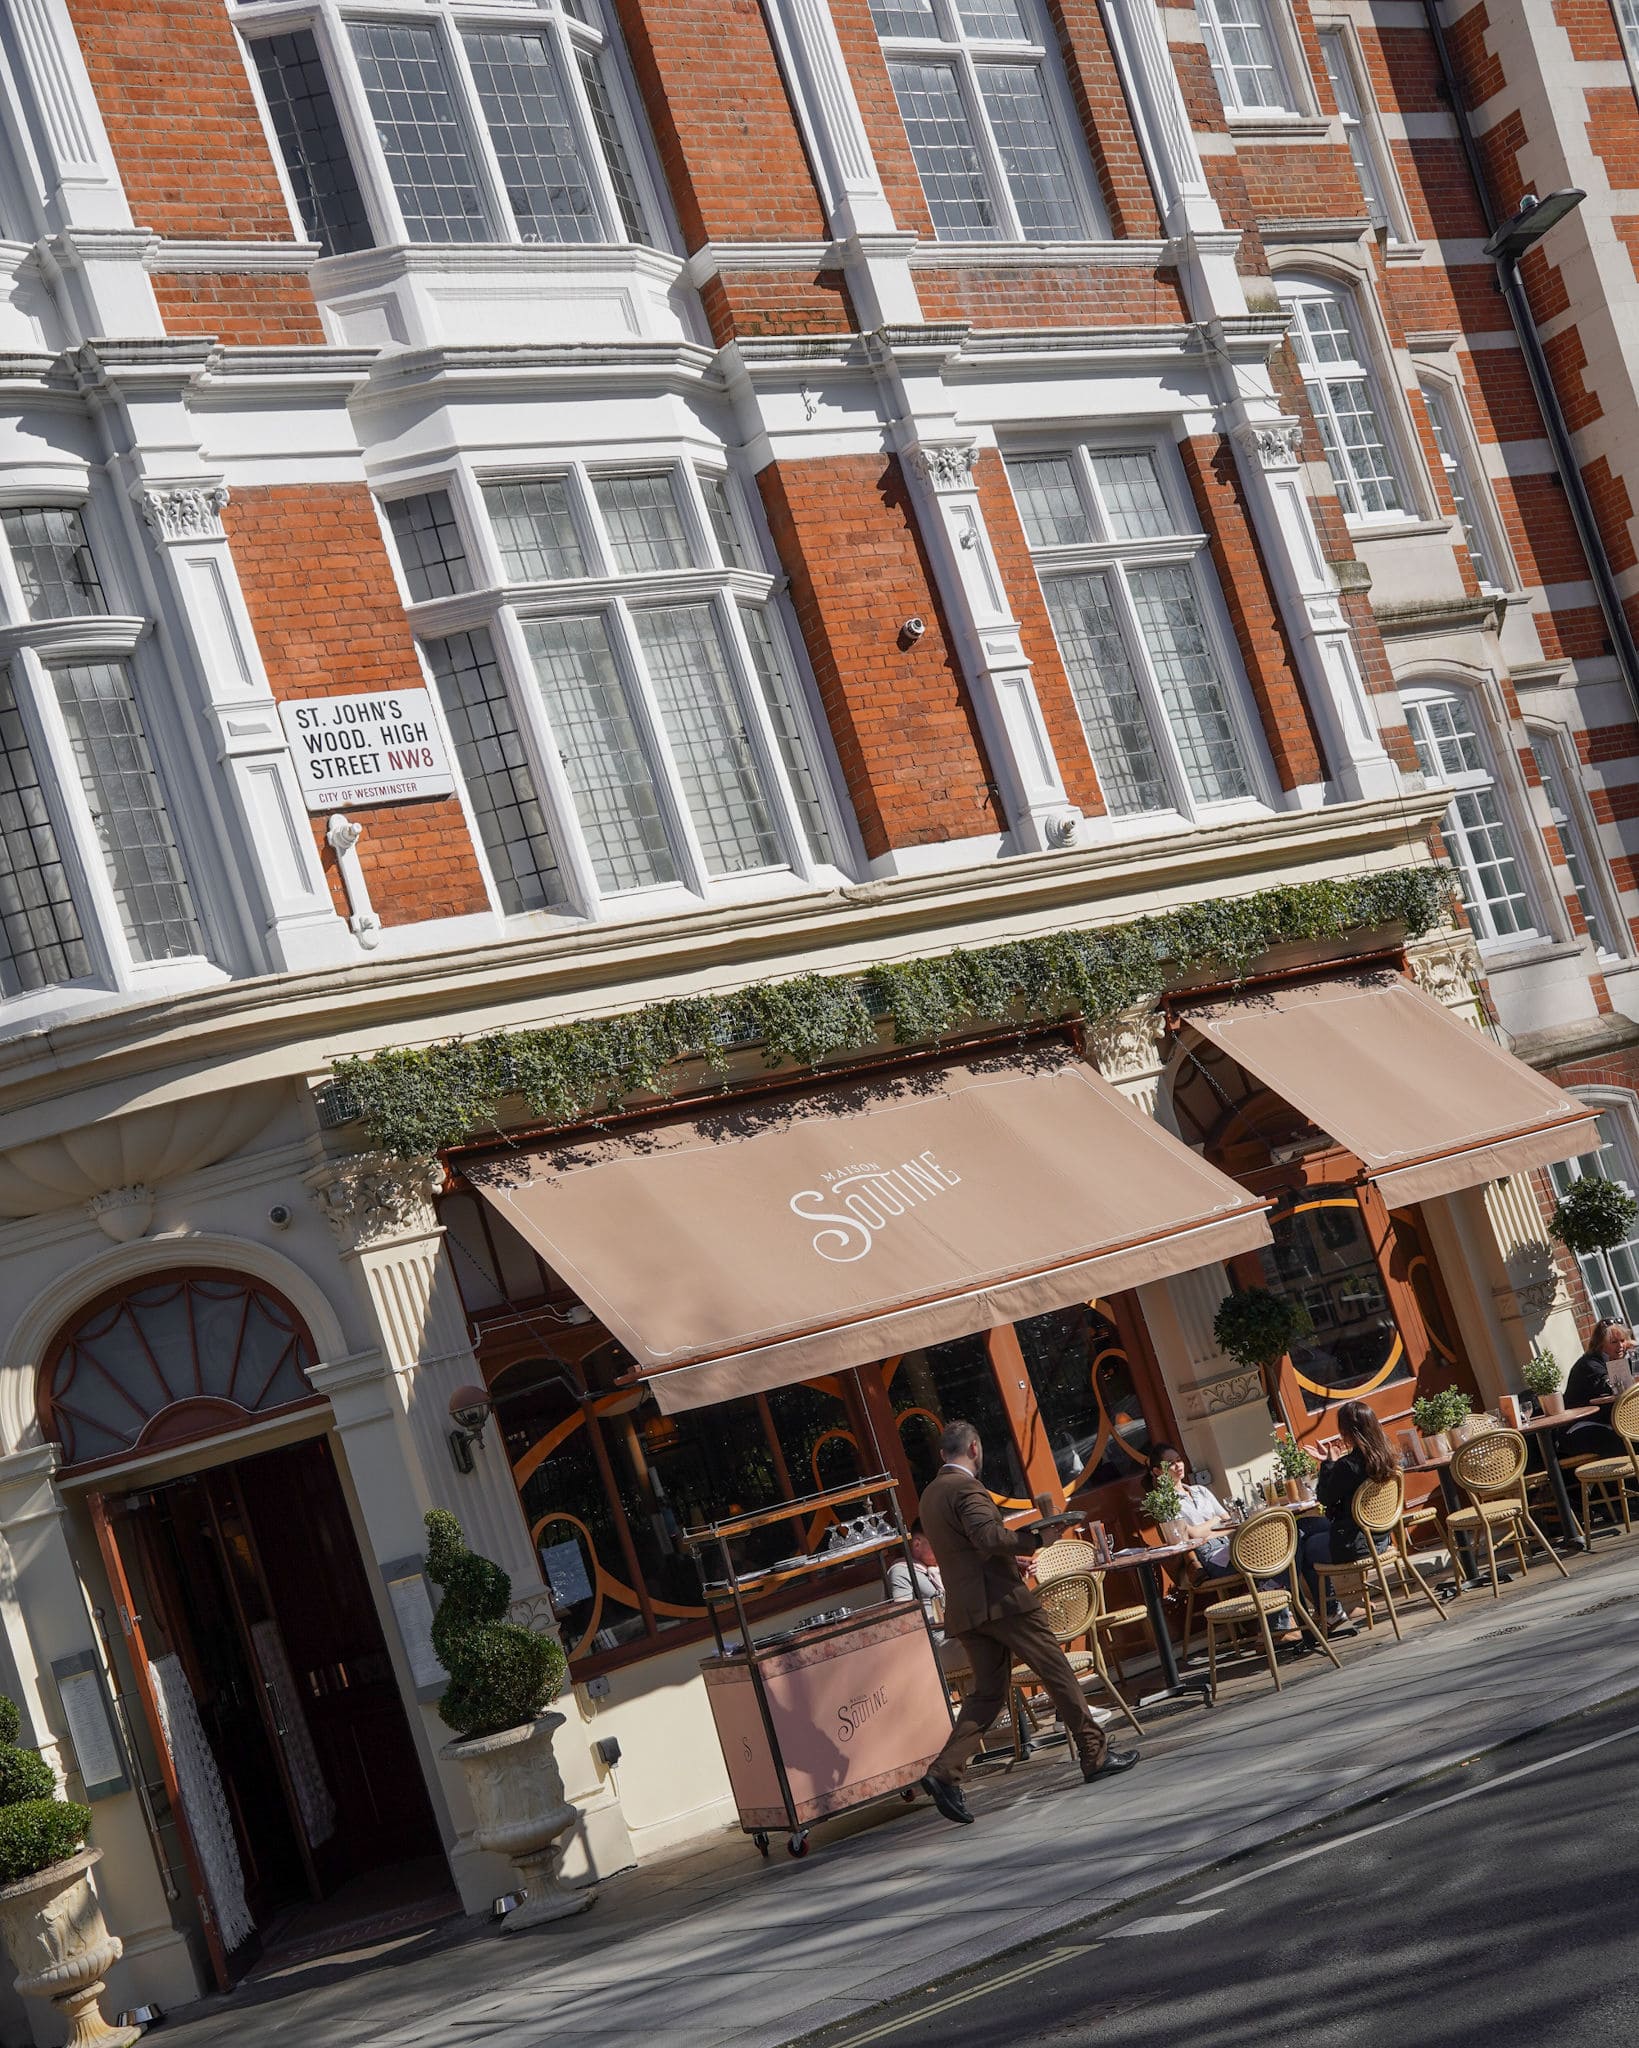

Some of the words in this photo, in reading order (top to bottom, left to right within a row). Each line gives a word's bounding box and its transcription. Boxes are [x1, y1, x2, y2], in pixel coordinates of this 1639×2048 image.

[296, 708, 326, 729] ST.
[332, 700, 403, 726] JOHN'S
[302, 729, 372, 754] WOOD.
[380, 722, 429, 746] HIGH
[310, 753, 382, 780] STREET
[388, 747, 434, 771] NW8
[318, 790, 338, 803] CITY
[342, 790, 353, 801] OF
[355, 782, 418, 798] WESTMINSTER
[820, 1161, 882, 1182] MAISON
[789, 1150, 962, 1262] SOUTINE
